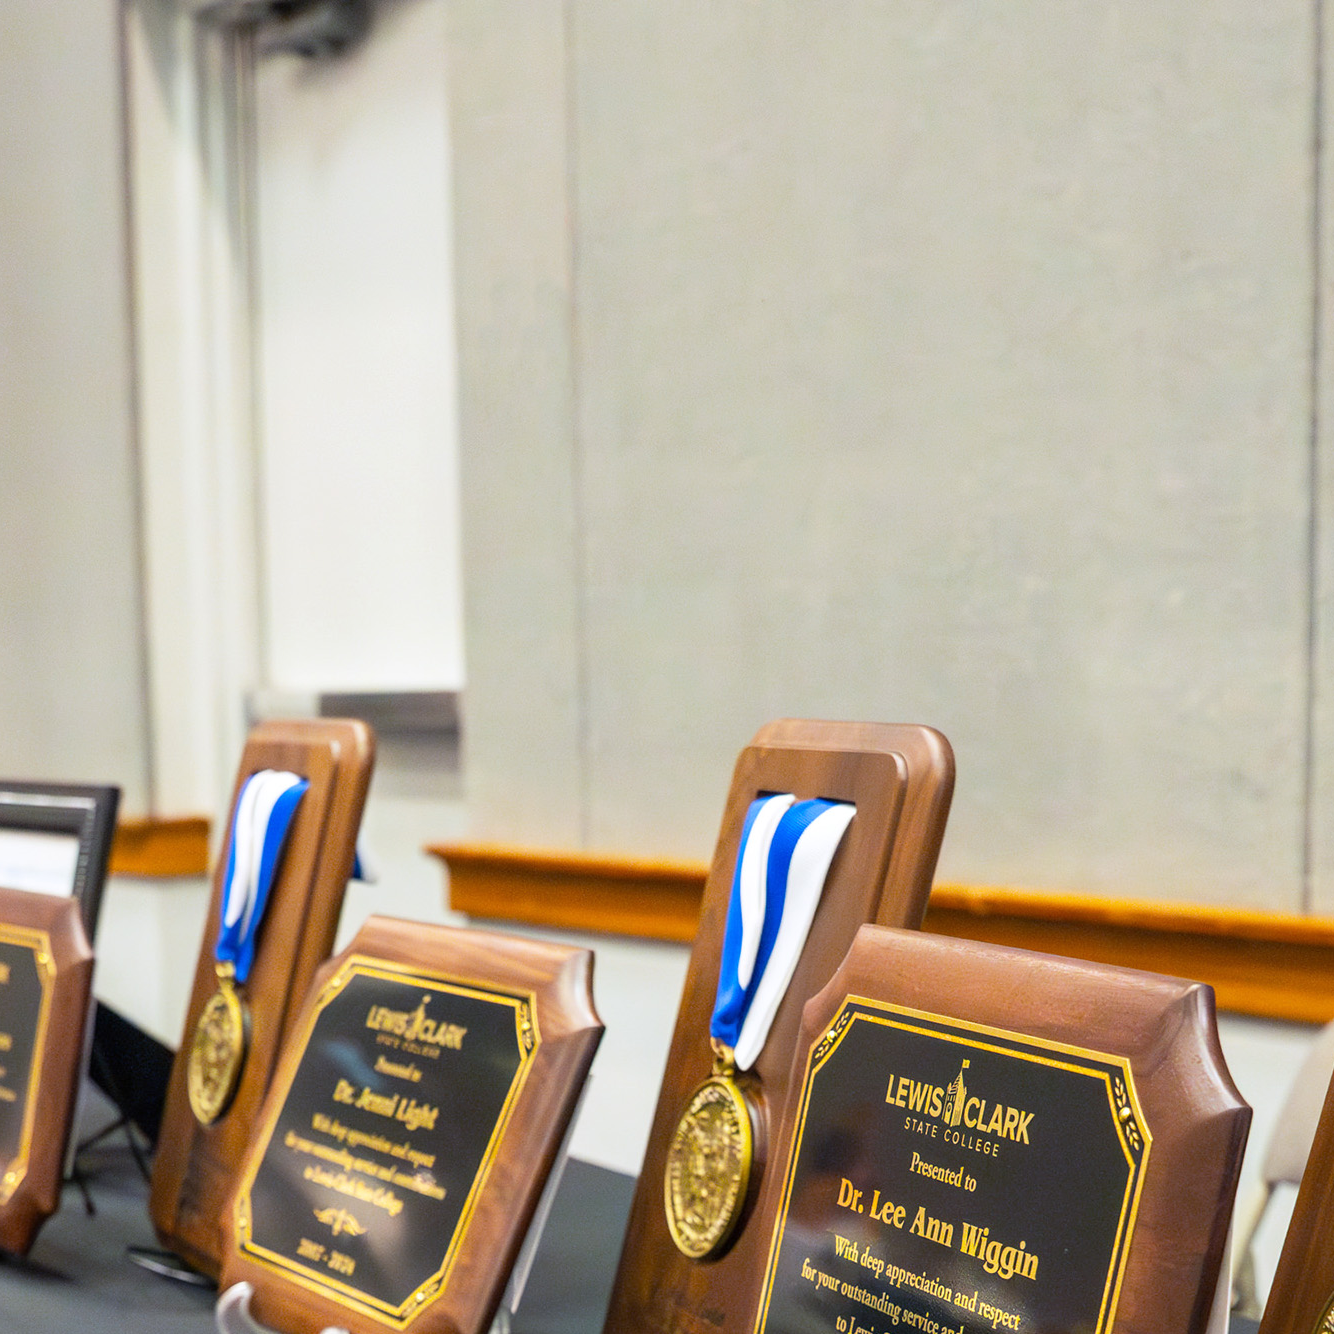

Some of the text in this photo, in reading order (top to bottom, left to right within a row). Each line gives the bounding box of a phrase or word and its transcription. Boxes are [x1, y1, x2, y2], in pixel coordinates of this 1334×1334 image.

[885, 1073, 1035, 1145] LEWIS CLARK
[904, 1116, 1000, 1158] STATE COLLEGE
[909, 1151, 977, 1193] Presented to
[836, 1177, 1040, 1281] Dr. Lee Ann Wiggin
[800, 1257, 817, 1282] for
[815, 1270, 841, 1290] your
[841, 1278, 902, 1326] outstanding
[834, 1233, 1021, 1331] With deep appreciation and respect
[835, 1315, 847, 1333] to
